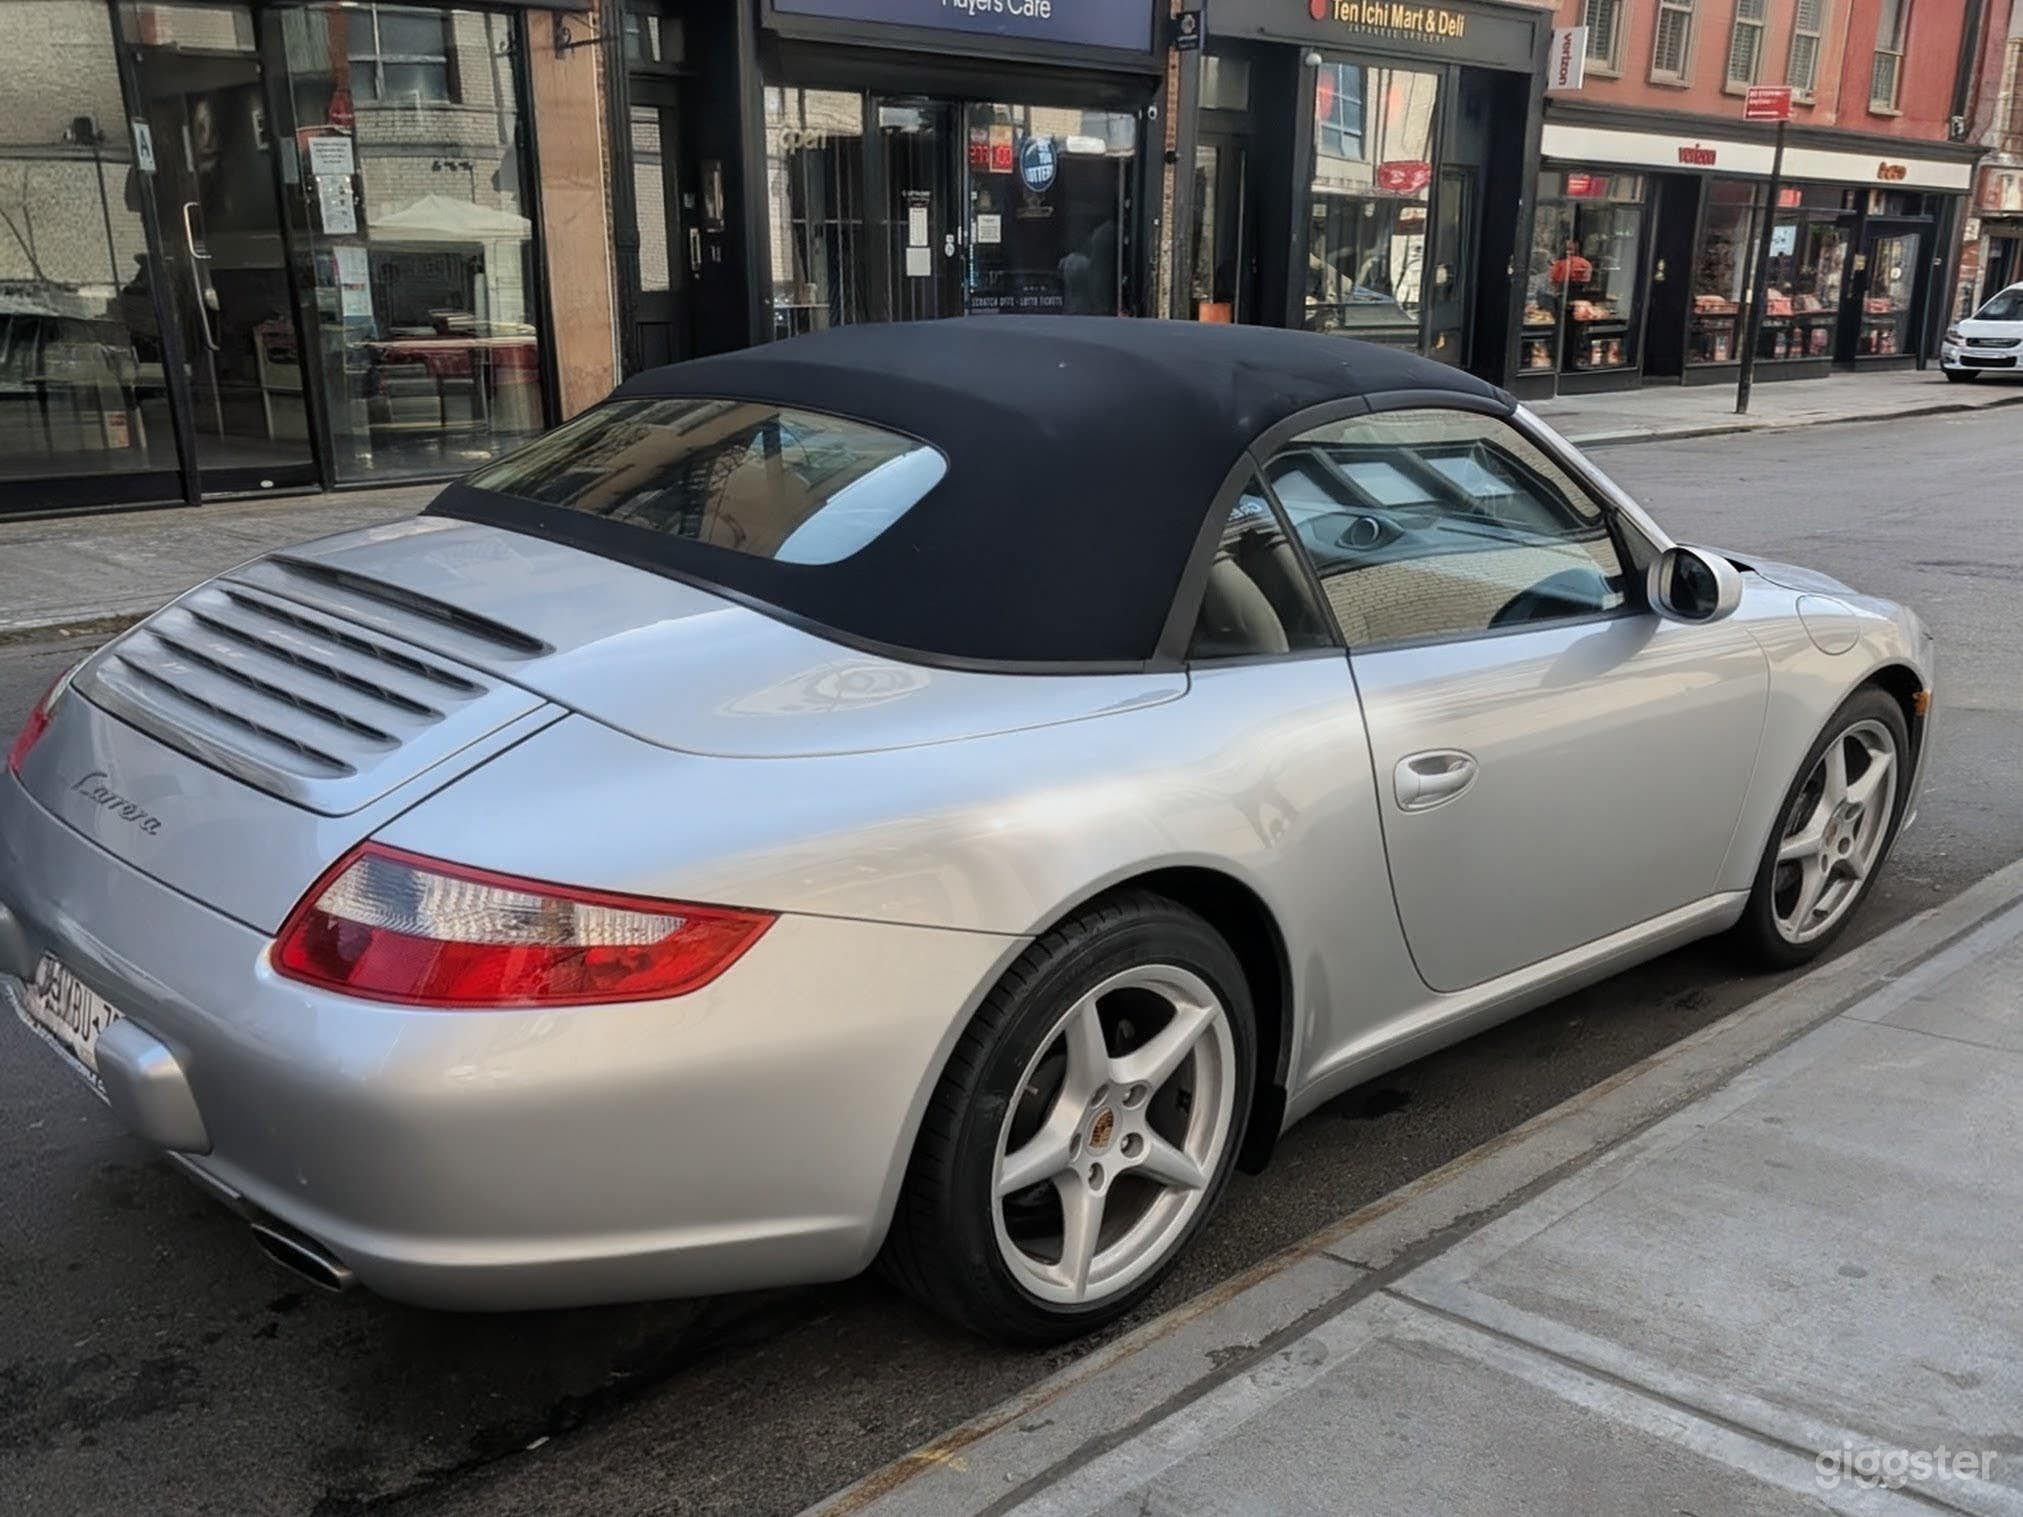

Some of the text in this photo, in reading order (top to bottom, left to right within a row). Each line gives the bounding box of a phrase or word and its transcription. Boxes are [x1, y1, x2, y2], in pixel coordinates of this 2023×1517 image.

[1007, 0, 1051, 19] Cafe
[1333, 0, 1465, 38] Ten Ichi Mart & Deli
[1558, 31, 1573, 86] verizon
[139, 128, 150, 157] A
[70, 771, 162, 836] Carrera
